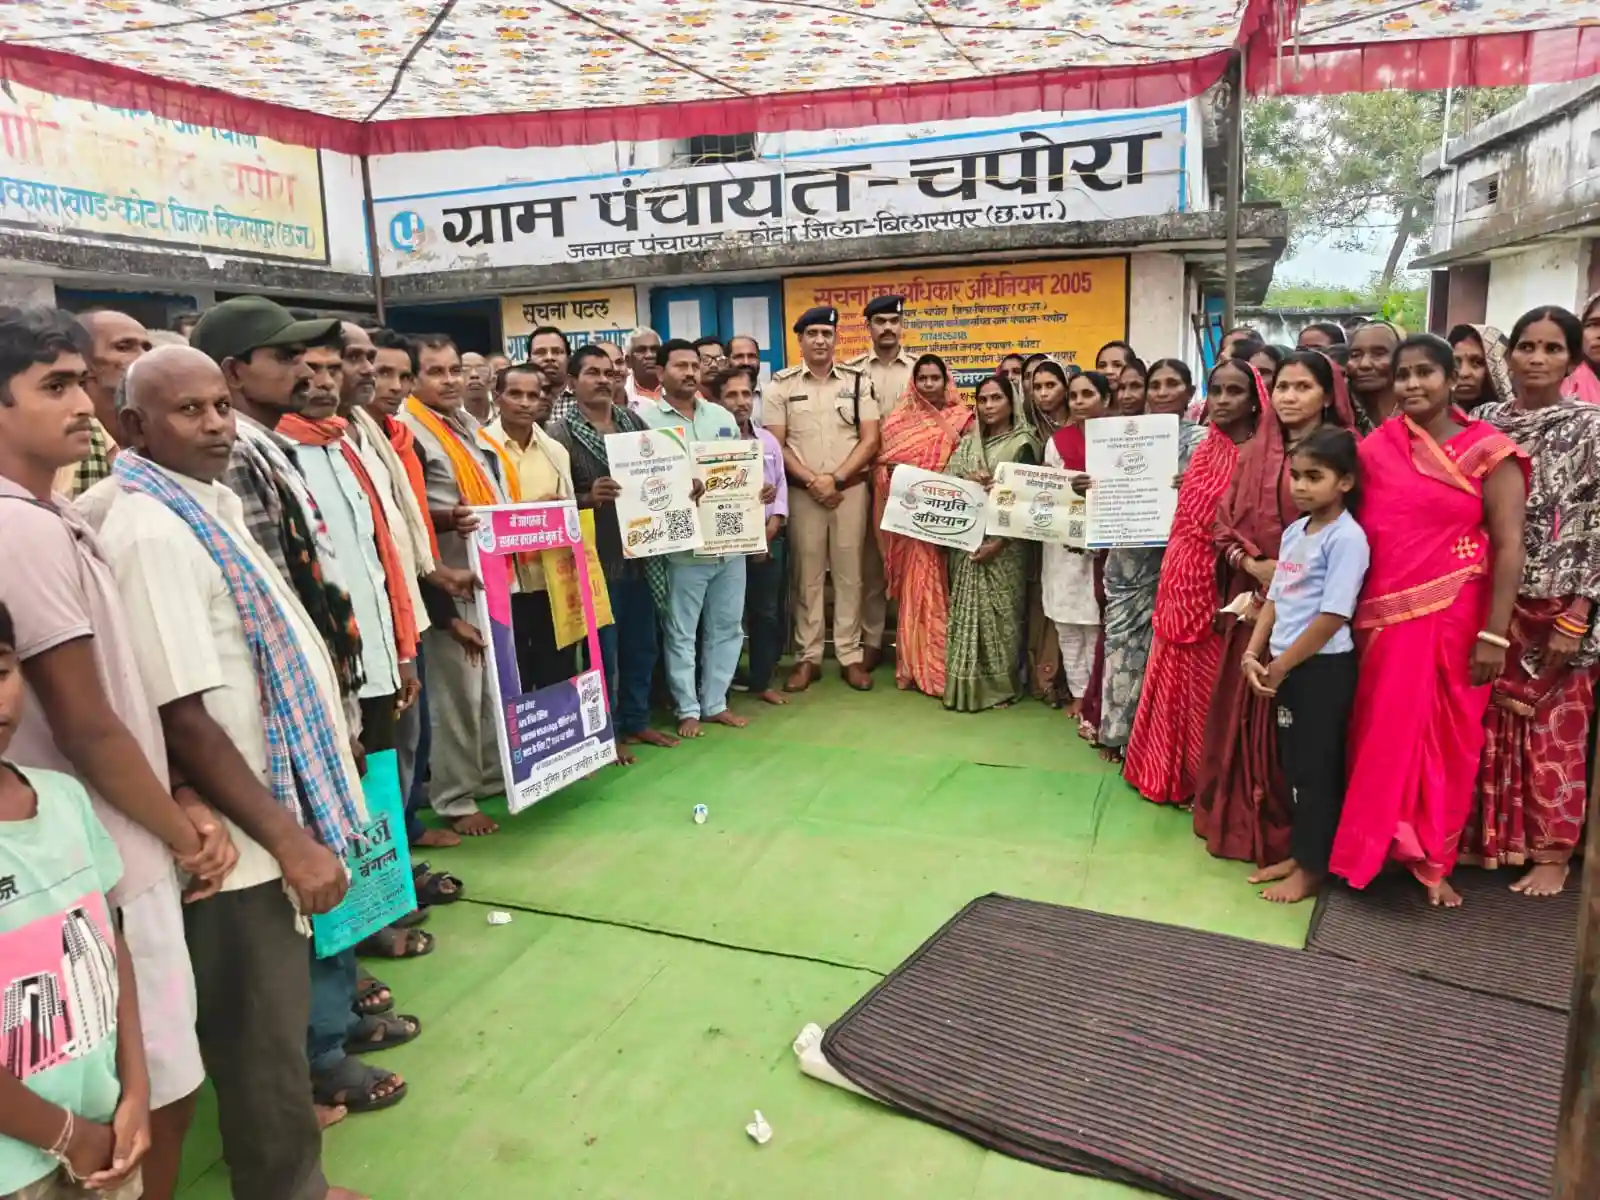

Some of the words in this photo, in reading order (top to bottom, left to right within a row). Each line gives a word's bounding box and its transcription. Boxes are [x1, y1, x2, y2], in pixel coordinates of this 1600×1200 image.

[442, 195, 577, 248] ग्राम
[566, 239, 634, 259] जनपद
[965, 270, 1048, 300] अधिनियम
[1050, 271, 1093, 295] 2005
[522, 301, 569, 327] सूचना
[571, 299, 610, 319] पटल
[924, 497, 969, 512] जागृति
[912, 512, 971, 528] अभियान
